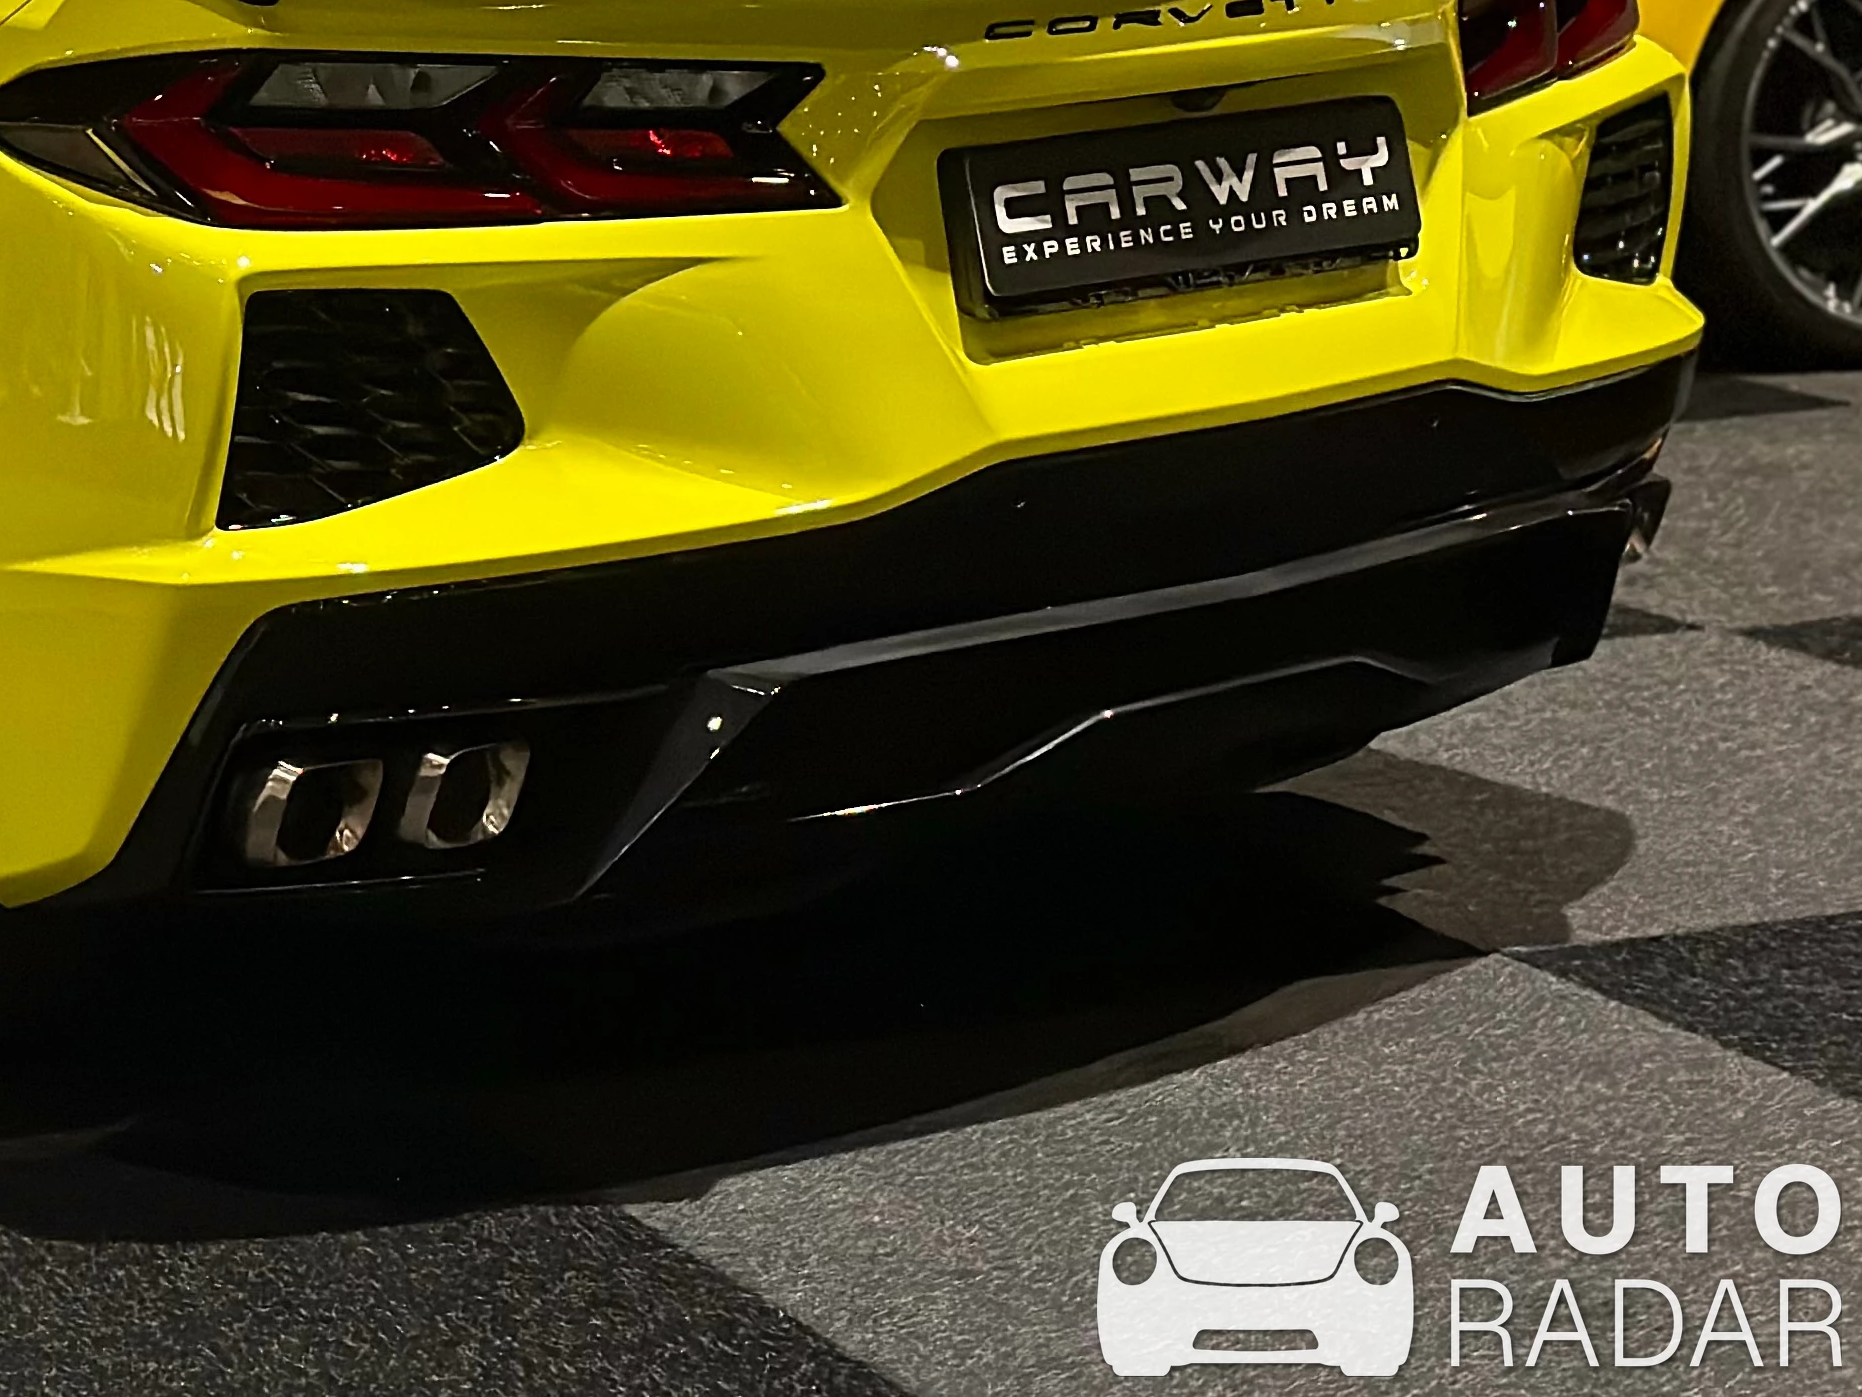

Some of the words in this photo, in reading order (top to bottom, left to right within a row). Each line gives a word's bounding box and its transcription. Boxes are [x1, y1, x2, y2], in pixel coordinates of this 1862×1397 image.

[992, 136, 1390, 235] CARWAY
[1001, 221, 1194, 266] EXPERIENCE
[1208, 209, 1288, 235] YOUR
[1302, 193, 1400, 224] DREAM
